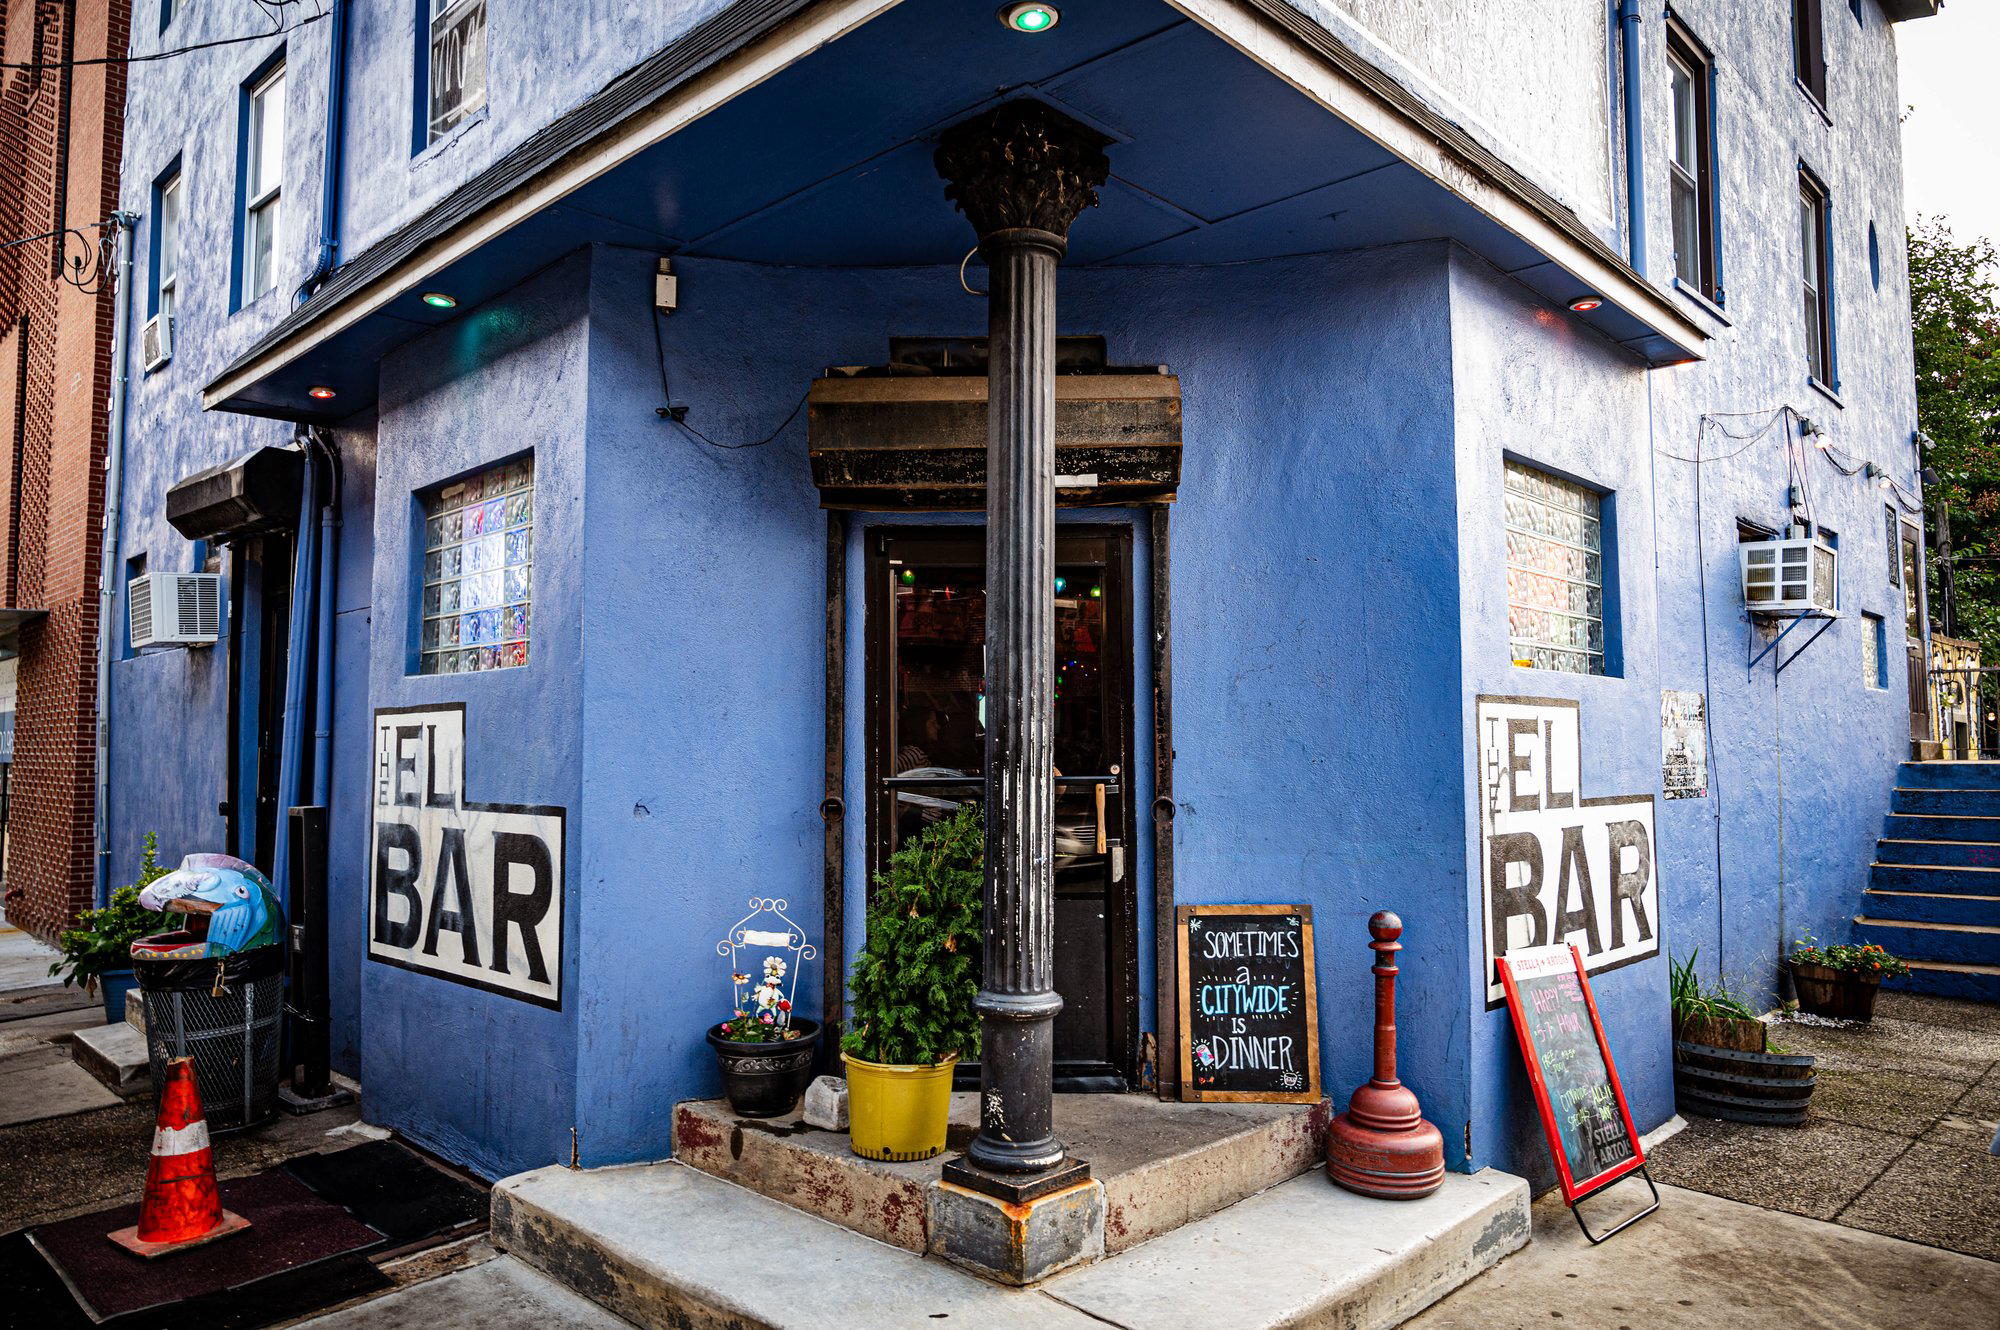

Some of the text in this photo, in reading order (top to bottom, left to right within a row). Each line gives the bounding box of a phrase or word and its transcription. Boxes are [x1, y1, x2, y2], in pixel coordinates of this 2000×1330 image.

[379, 726, 391, 806] THE
[394, 721, 457, 808] EL
[1486, 717, 1502, 813] THE
[1506, 716, 1574, 813] EL
[373, 822, 553, 985] BAR
[1487, 820, 1654, 986] BAR
[1203, 931, 1299, 959] SOMETIMES
[1236, 966, 1251, 985] a
[1516, 959, 1541, 973] STELLA
[1201, 984, 1290, 1015] CITYWIDE
[1232, 1017, 1247, 1034] IS
[1556, 1012, 1583, 1034] HOUR
[1212, 1036, 1294, 1071] DINNER
[1593, 1121, 1627, 1146] STELLA
[1599, 1139, 1634, 1165] ARTOIS
